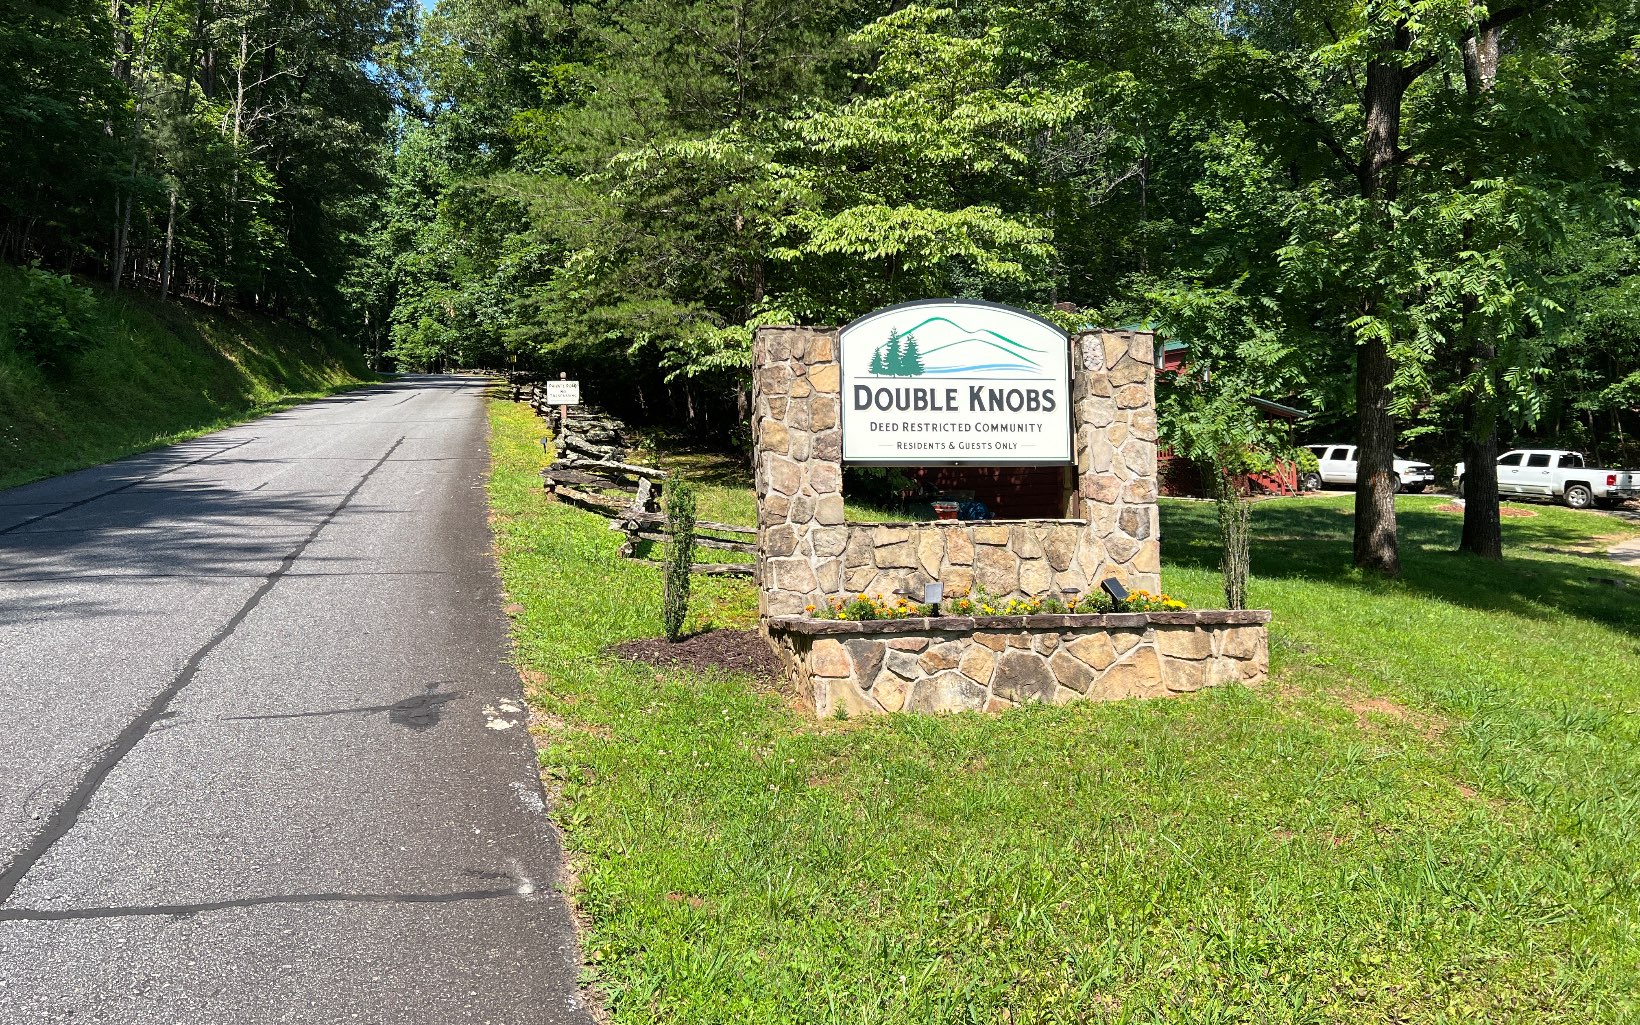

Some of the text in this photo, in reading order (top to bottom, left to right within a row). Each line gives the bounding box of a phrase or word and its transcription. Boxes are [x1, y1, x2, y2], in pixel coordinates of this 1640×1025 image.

[853, 384, 1057, 413] DOUBLE KNOBS
[870, 421, 1043, 433] DEED RESTRICTED COMMUNITY
[896, 441, 1017, 450] RESIDENTS & GUESTS ONLY
